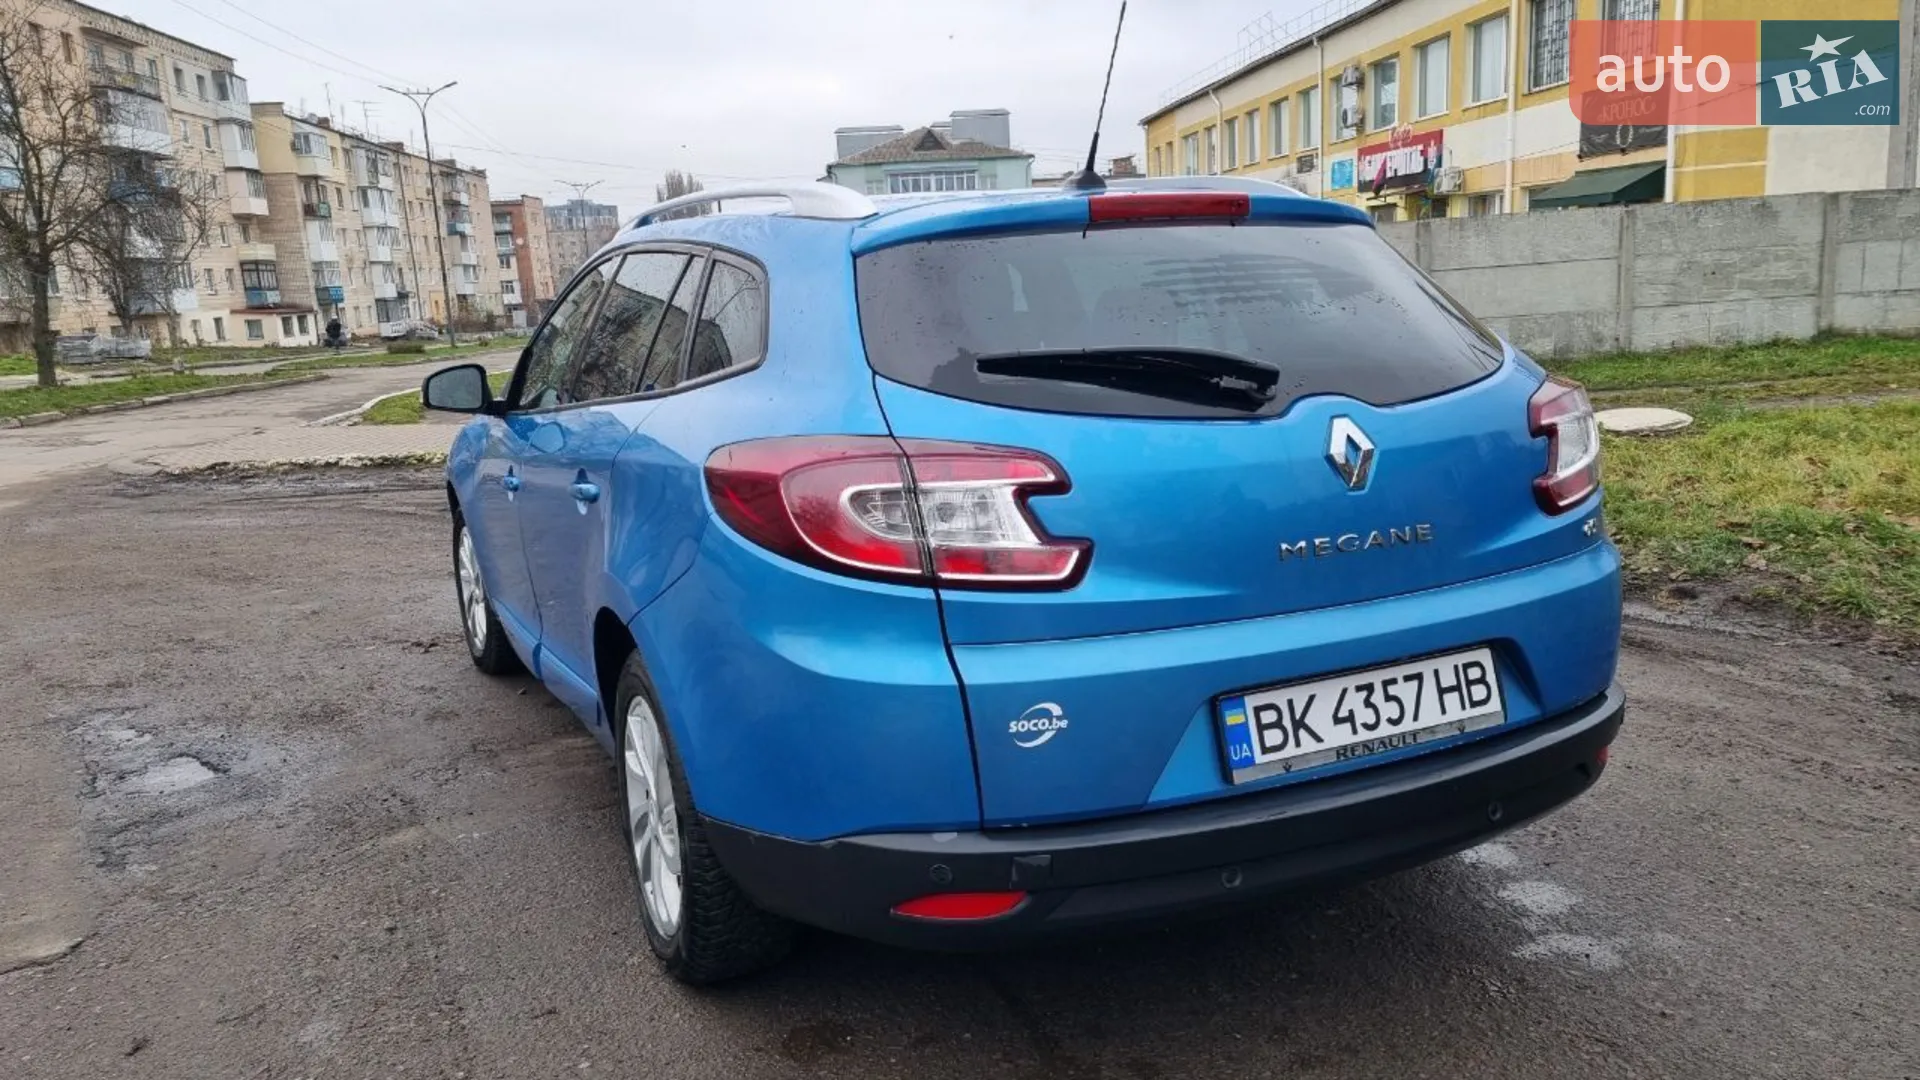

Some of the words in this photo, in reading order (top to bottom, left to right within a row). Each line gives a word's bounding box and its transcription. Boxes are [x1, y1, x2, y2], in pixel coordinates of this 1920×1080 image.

[1280, 523, 1434, 562] MEGANE
[1253, 693, 1324, 756] BK
[1332, 671, 1424, 736] 4357
[1433, 660, 1493, 716] HB
[1231, 743, 1251, 762] UA
[1336, 731, 1421, 761] RENAULT
